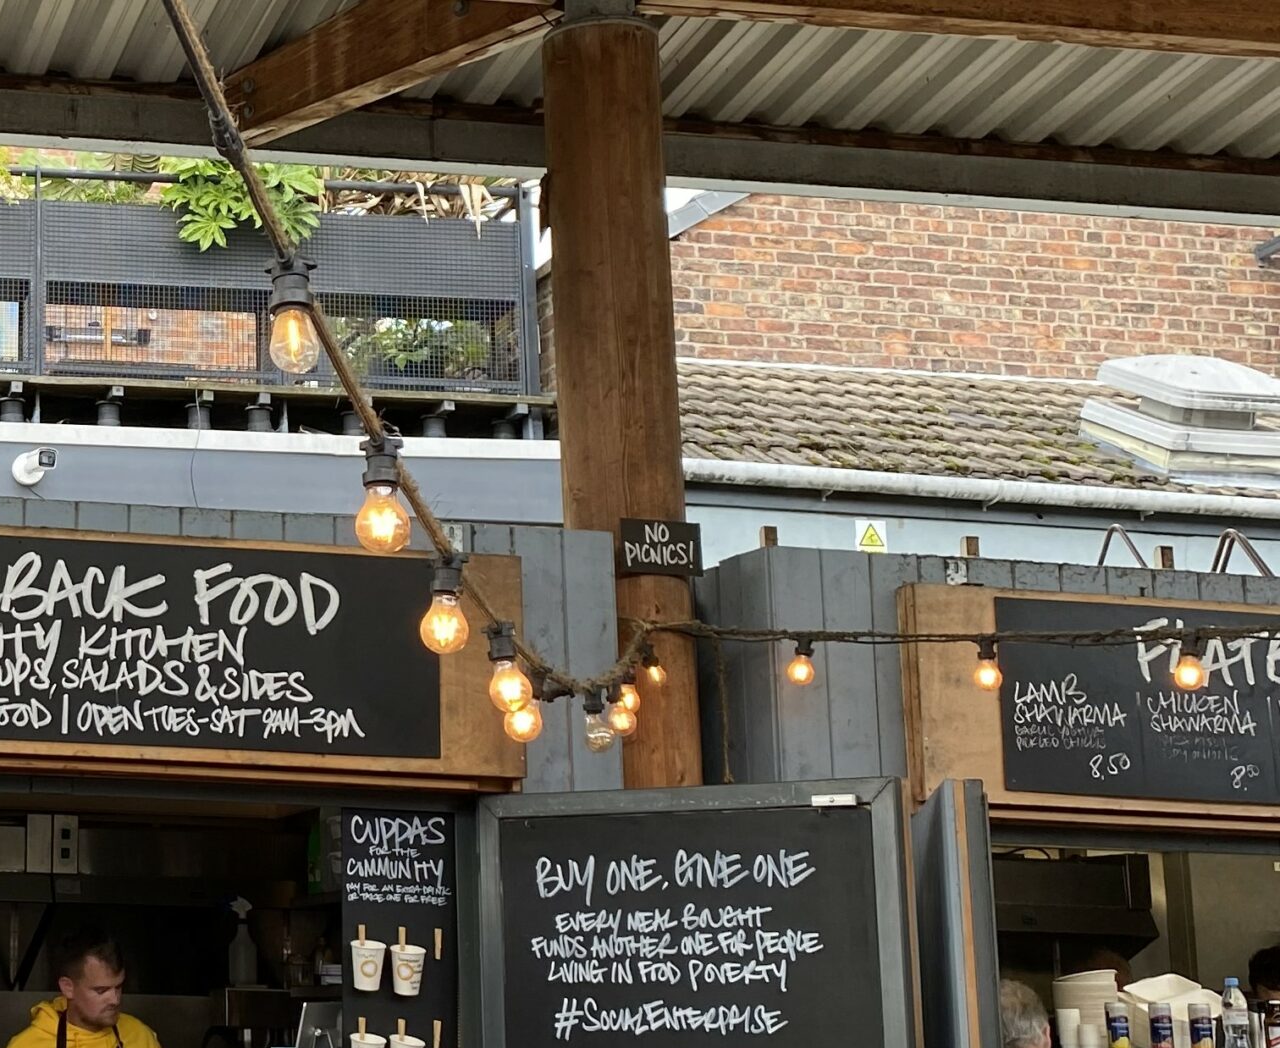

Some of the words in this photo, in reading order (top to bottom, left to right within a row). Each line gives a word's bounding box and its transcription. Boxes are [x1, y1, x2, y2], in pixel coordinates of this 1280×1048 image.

[645, 522, 669, 543] NO
[625, 541, 693, 568] PICNICS!
[194, 563, 339, 635] FOOD
[79, 624, 247, 666] KITCHEN
[1133, 617, 1280, 688] FLAT
[62, 658, 189, 695] SALADS
[1014, 673, 1087, 705] LAMB
[1014, 703, 1127, 728] SHAWARMA
[1147, 690, 1240, 715] CHICKEN
[77, 700, 144, 736] OPEN
[144, 705, 261, 737] TUES-SAT
[262, 707, 365, 743] 9AM-3PM
[1150, 711, 1256, 736] SHAWARMA
[351, 815, 445, 850] CUPPAS
[392, 847, 421, 858] THE
[347, 856, 444, 884] COMMUNITY
[535, 855, 595, 906] BUY
[606, 854, 669, 895] ONE,
[675, 849, 750, 888] GIVE
[753, 849, 816, 888] ONE
[555, 908, 622, 937] EVERY
[627, 908, 678, 932] MEAL
[681, 903, 772, 930] BOUGHT
[531, 934, 587, 959] FUNDS
[591, 933, 678, 959] ANOTHER
[681, 930, 718, 956] ONE
[717, 929, 753, 956] FOR
[755, 928, 823, 961] PEOPLE
[547, 960, 608, 984] LIVING
[611, 958, 633, 984] IN
[637, 960, 681, 985] FOOD
[689, 959, 787, 992] POVERTY
